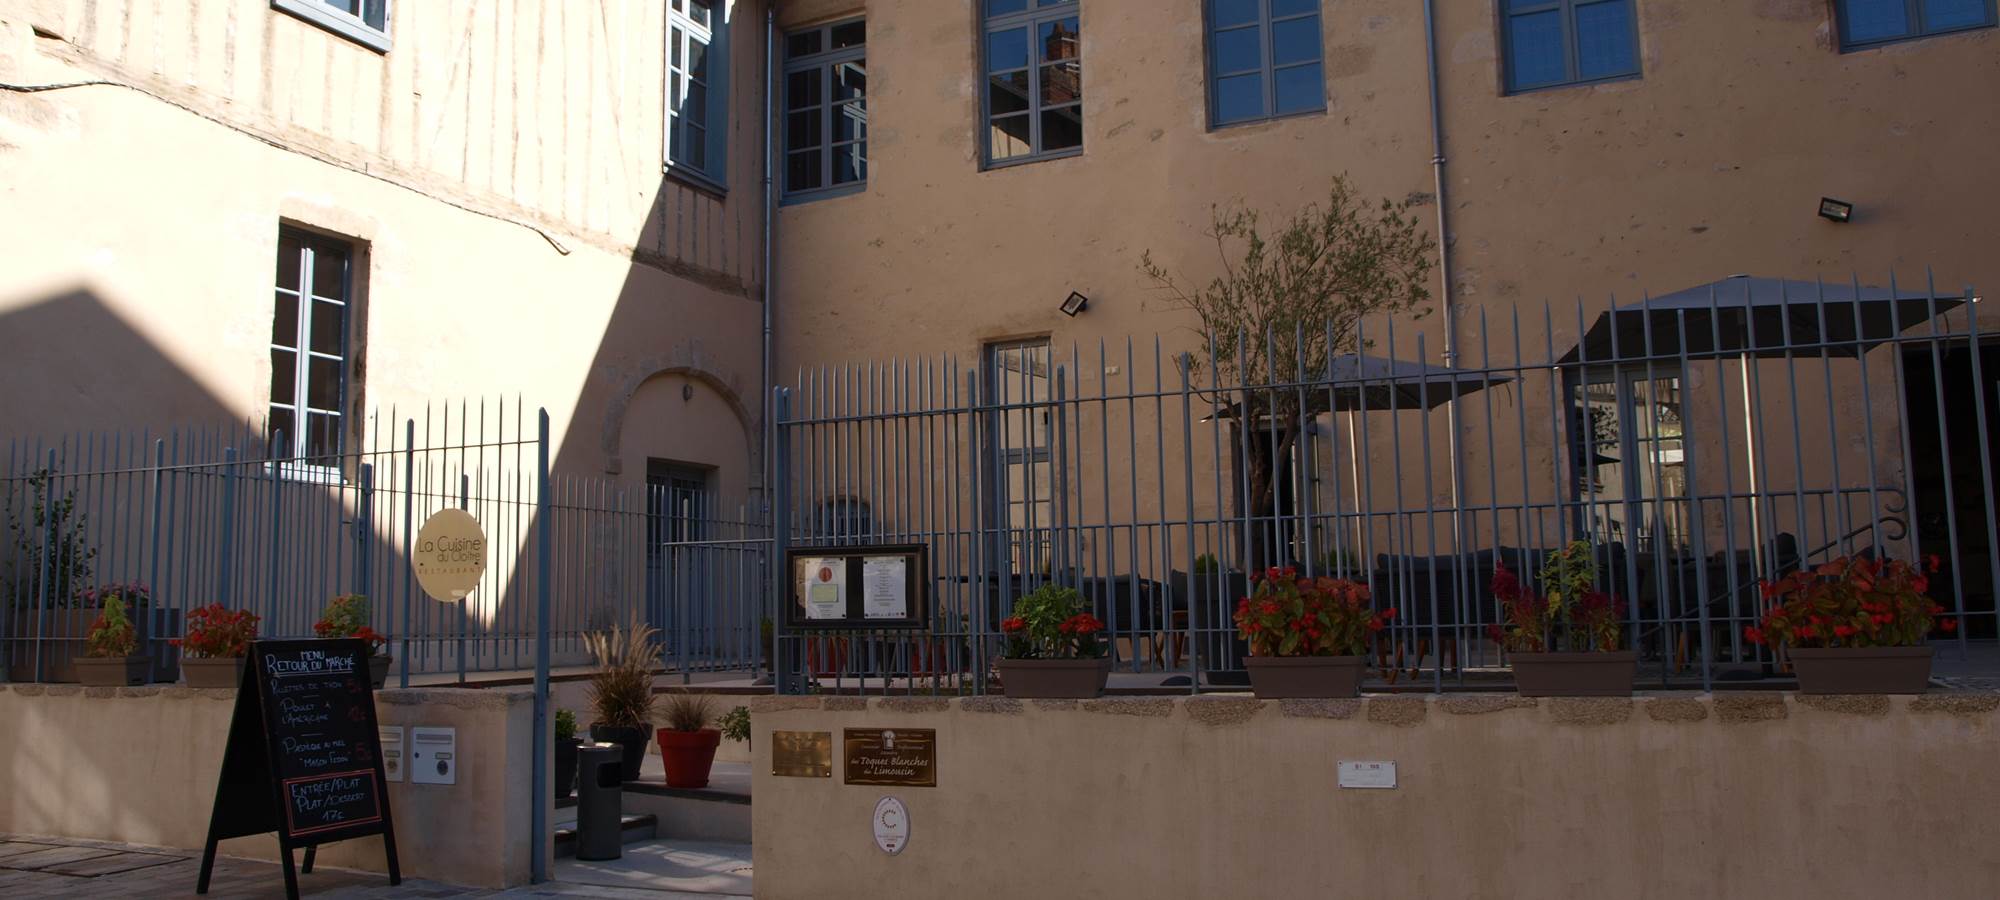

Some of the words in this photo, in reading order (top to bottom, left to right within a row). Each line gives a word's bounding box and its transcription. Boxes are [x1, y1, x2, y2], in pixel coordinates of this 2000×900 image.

[418, 539, 433, 553] La
[437, 535, 481, 552] Cuisine
[437, 551, 449, 562] du
[418, 567, 481, 575] RESTAURANT
[300, 650, 325, 661] MENU
[310, 661, 323, 671] DU
[860, 756, 889, 769] Toques
[890, 754, 929, 767] Blanches
[873, 766, 916, 776] Limousin
